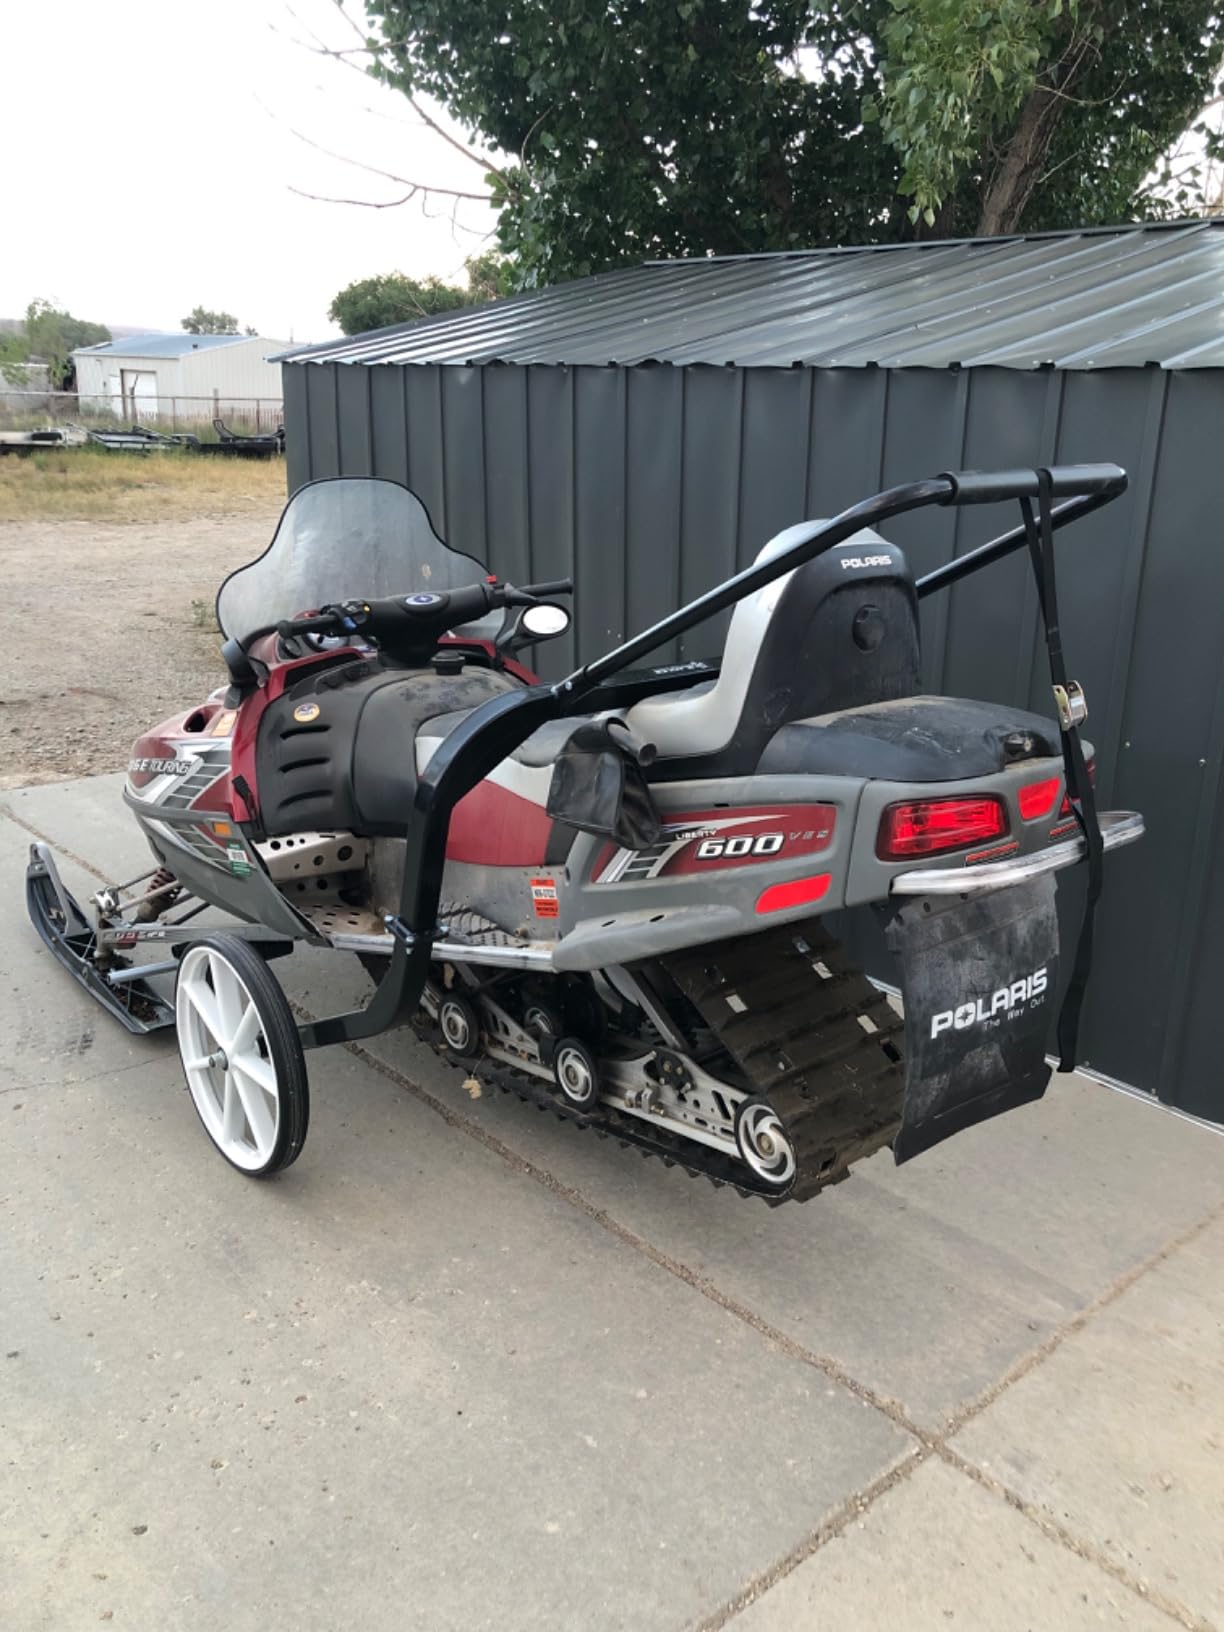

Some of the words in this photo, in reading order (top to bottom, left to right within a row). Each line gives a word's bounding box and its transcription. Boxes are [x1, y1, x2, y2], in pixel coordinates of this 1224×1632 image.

[840, 554, 892, 569] POLARIS
[150, 759, 193, 776] TOURING
[675, 829, 718, 841] LIBERTY
[696, 832, 786, 860] 600
[930, 967, 1048, 1040] POLARIS
[983, 1018, 1001, 1031] The
[1007, 1007, 1025, 1021] Way
[1029, 995, 1046, 1009] Out
